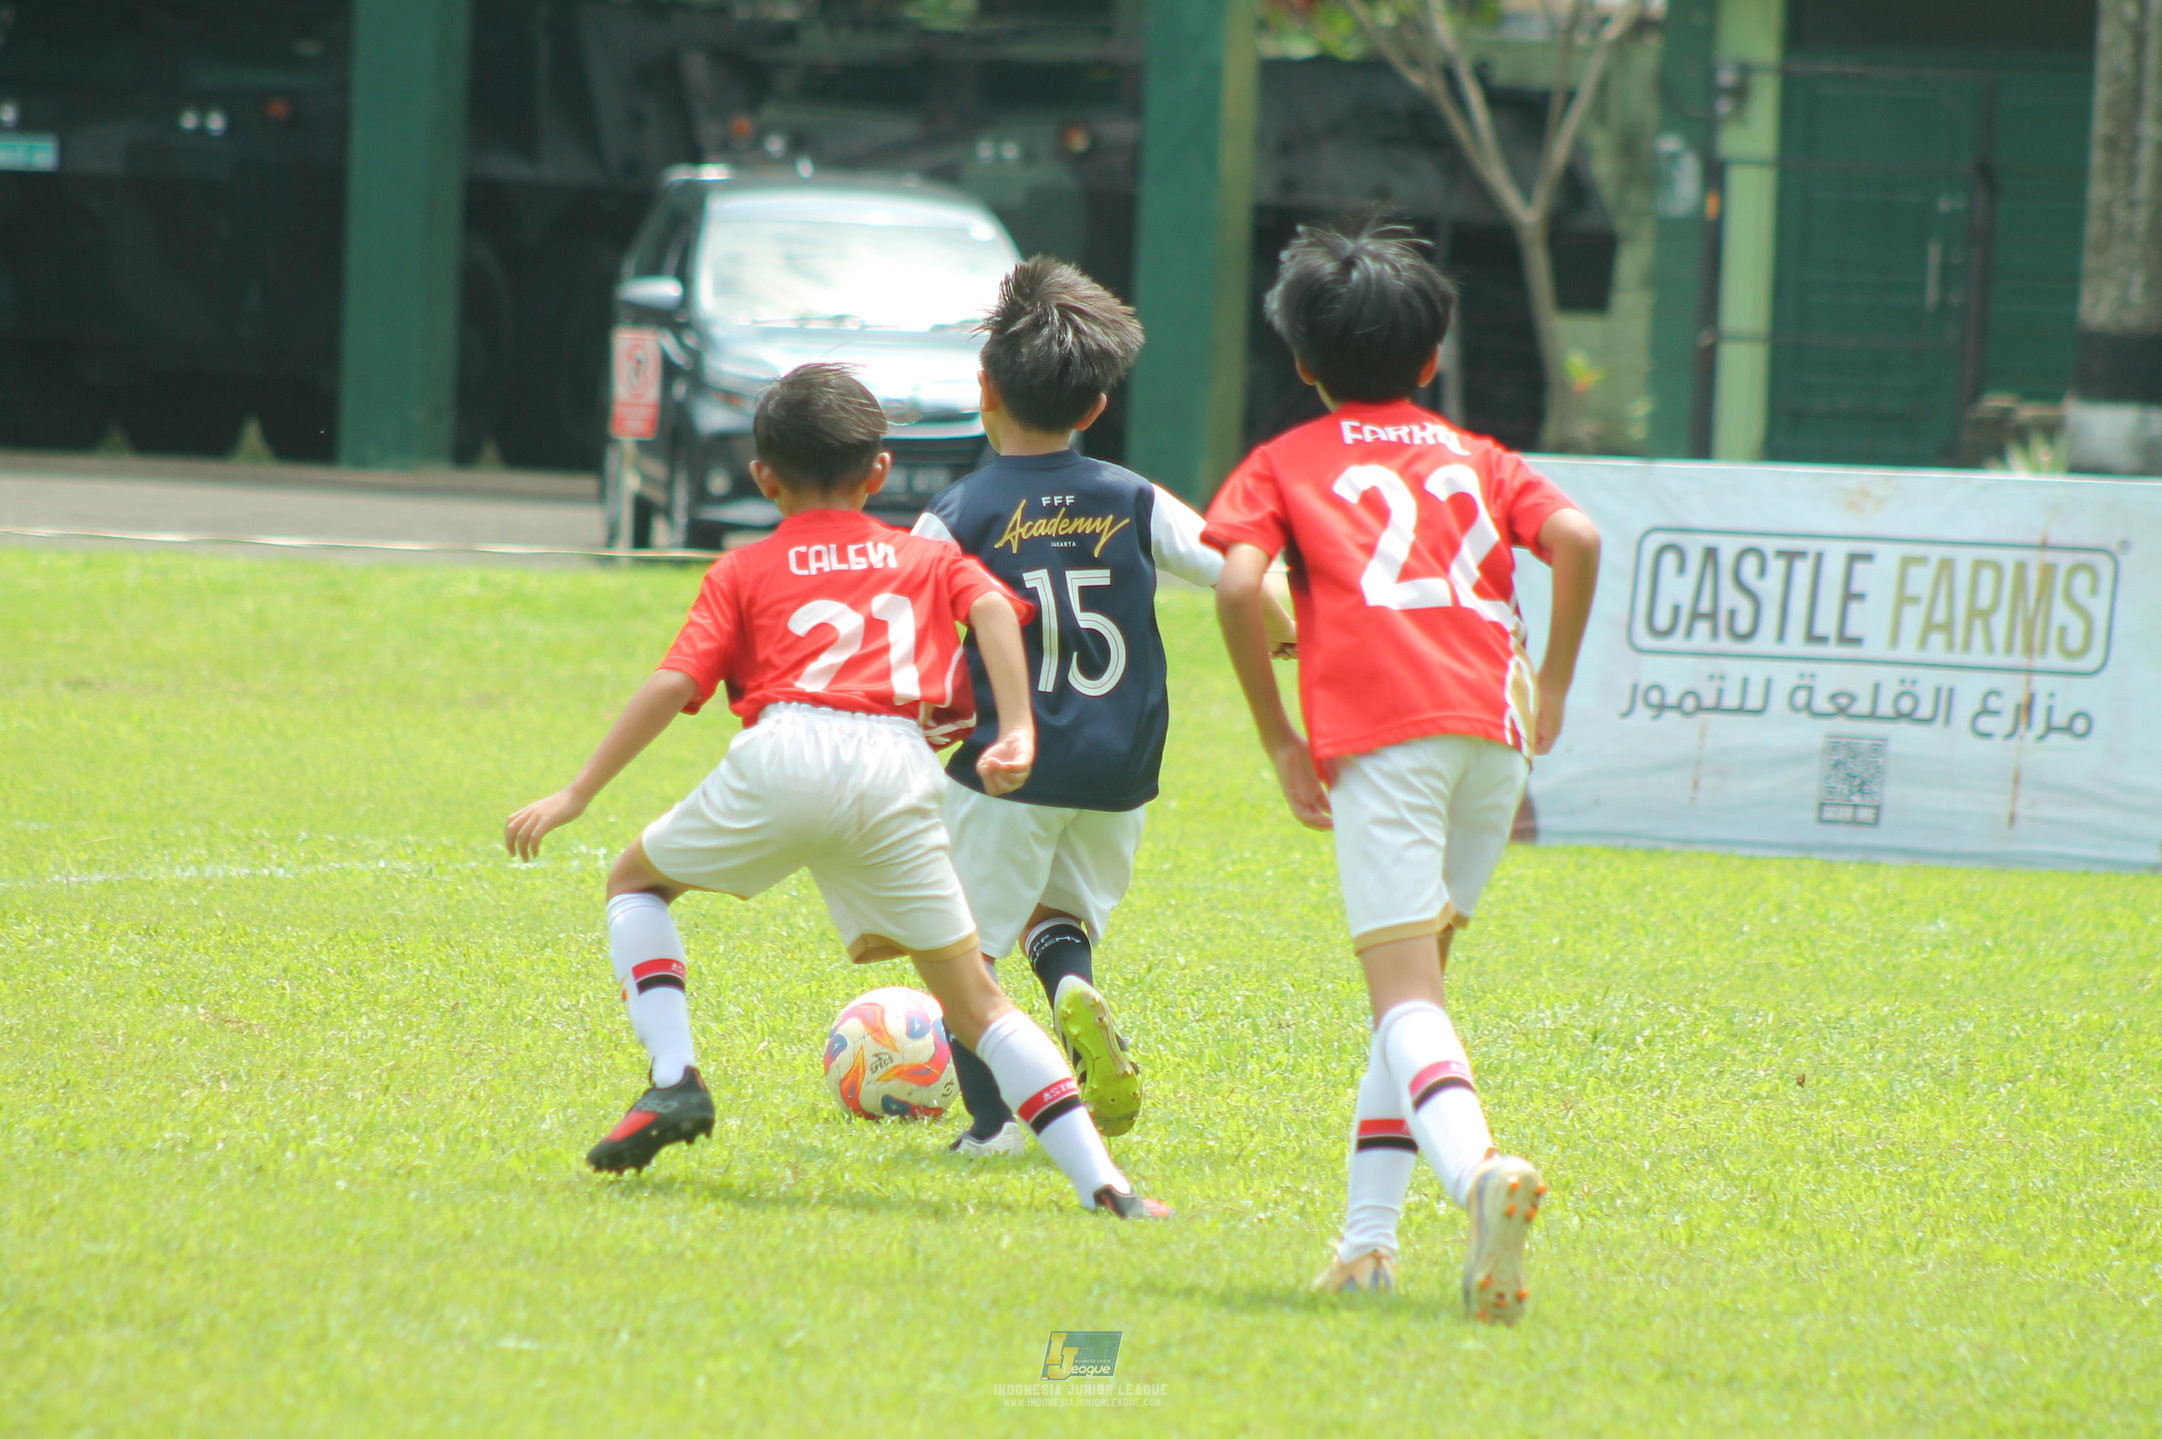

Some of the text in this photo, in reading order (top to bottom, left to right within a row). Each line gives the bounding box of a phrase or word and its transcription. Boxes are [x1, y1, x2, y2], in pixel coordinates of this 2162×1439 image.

[993, 499, 1130, 558] Academy
[1041, 495, 1075, 507] FFF
[1331, 463, 1520, 636] 22
[786, 592, 922, 706] 21
[1021, 568, 1127, 697] 15
[1644, 543, 2100, 661] CASTLE FARMS
[1618, 672, 2094, 742] مزارع القلعة للتمور
